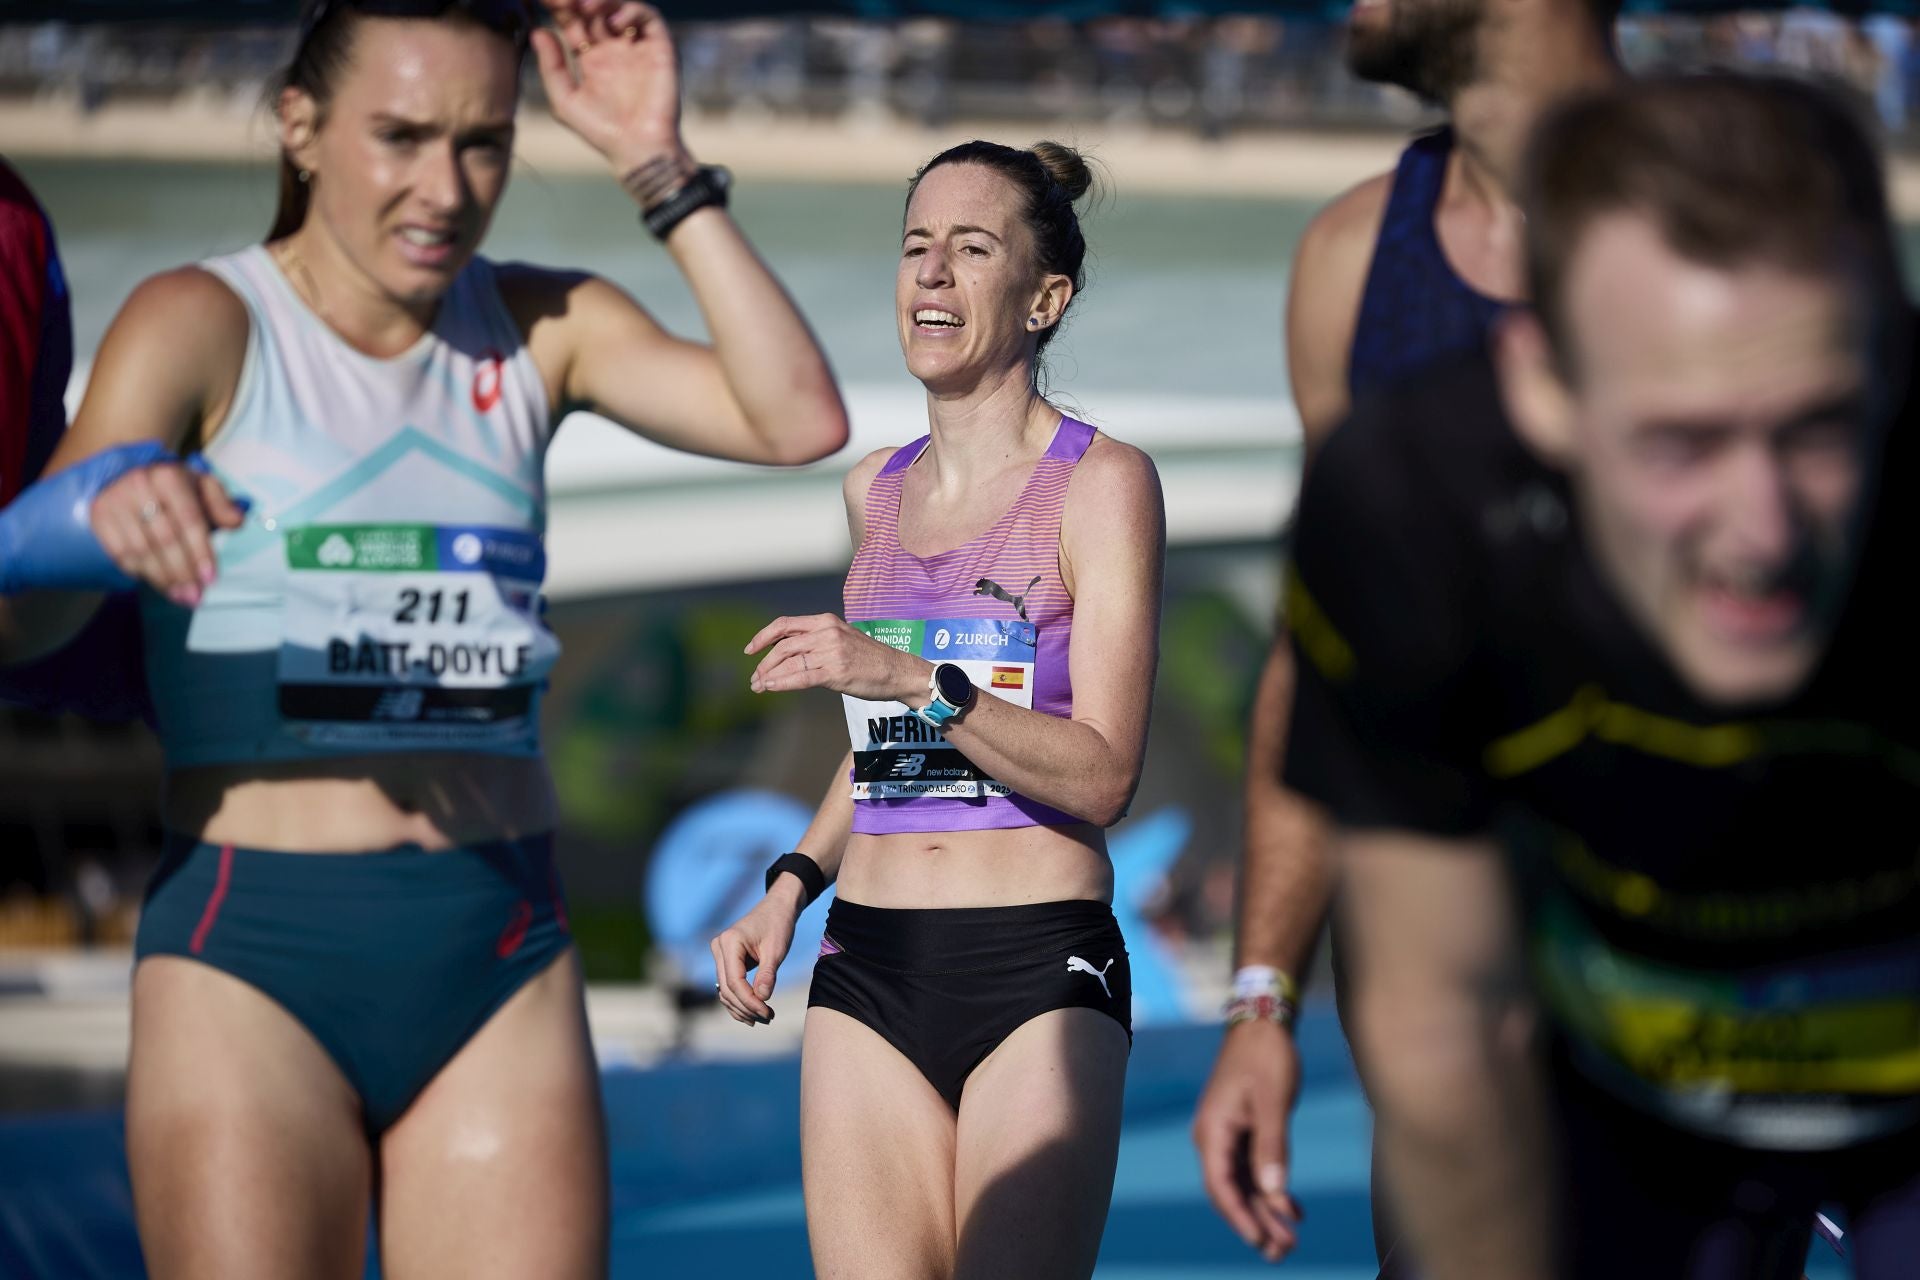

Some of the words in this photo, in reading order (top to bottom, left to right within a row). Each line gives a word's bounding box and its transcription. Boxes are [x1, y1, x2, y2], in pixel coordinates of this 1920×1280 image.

[394, 588, 470, 624] 211
[955, 633, 1009, 647] ZURICH
[868, 715, 946, 744] MERIT
[927, 769, 943, 777] new
[898, 784, 935, 794] TRINIDAD
[990, 784, 1011, 794] 2025
